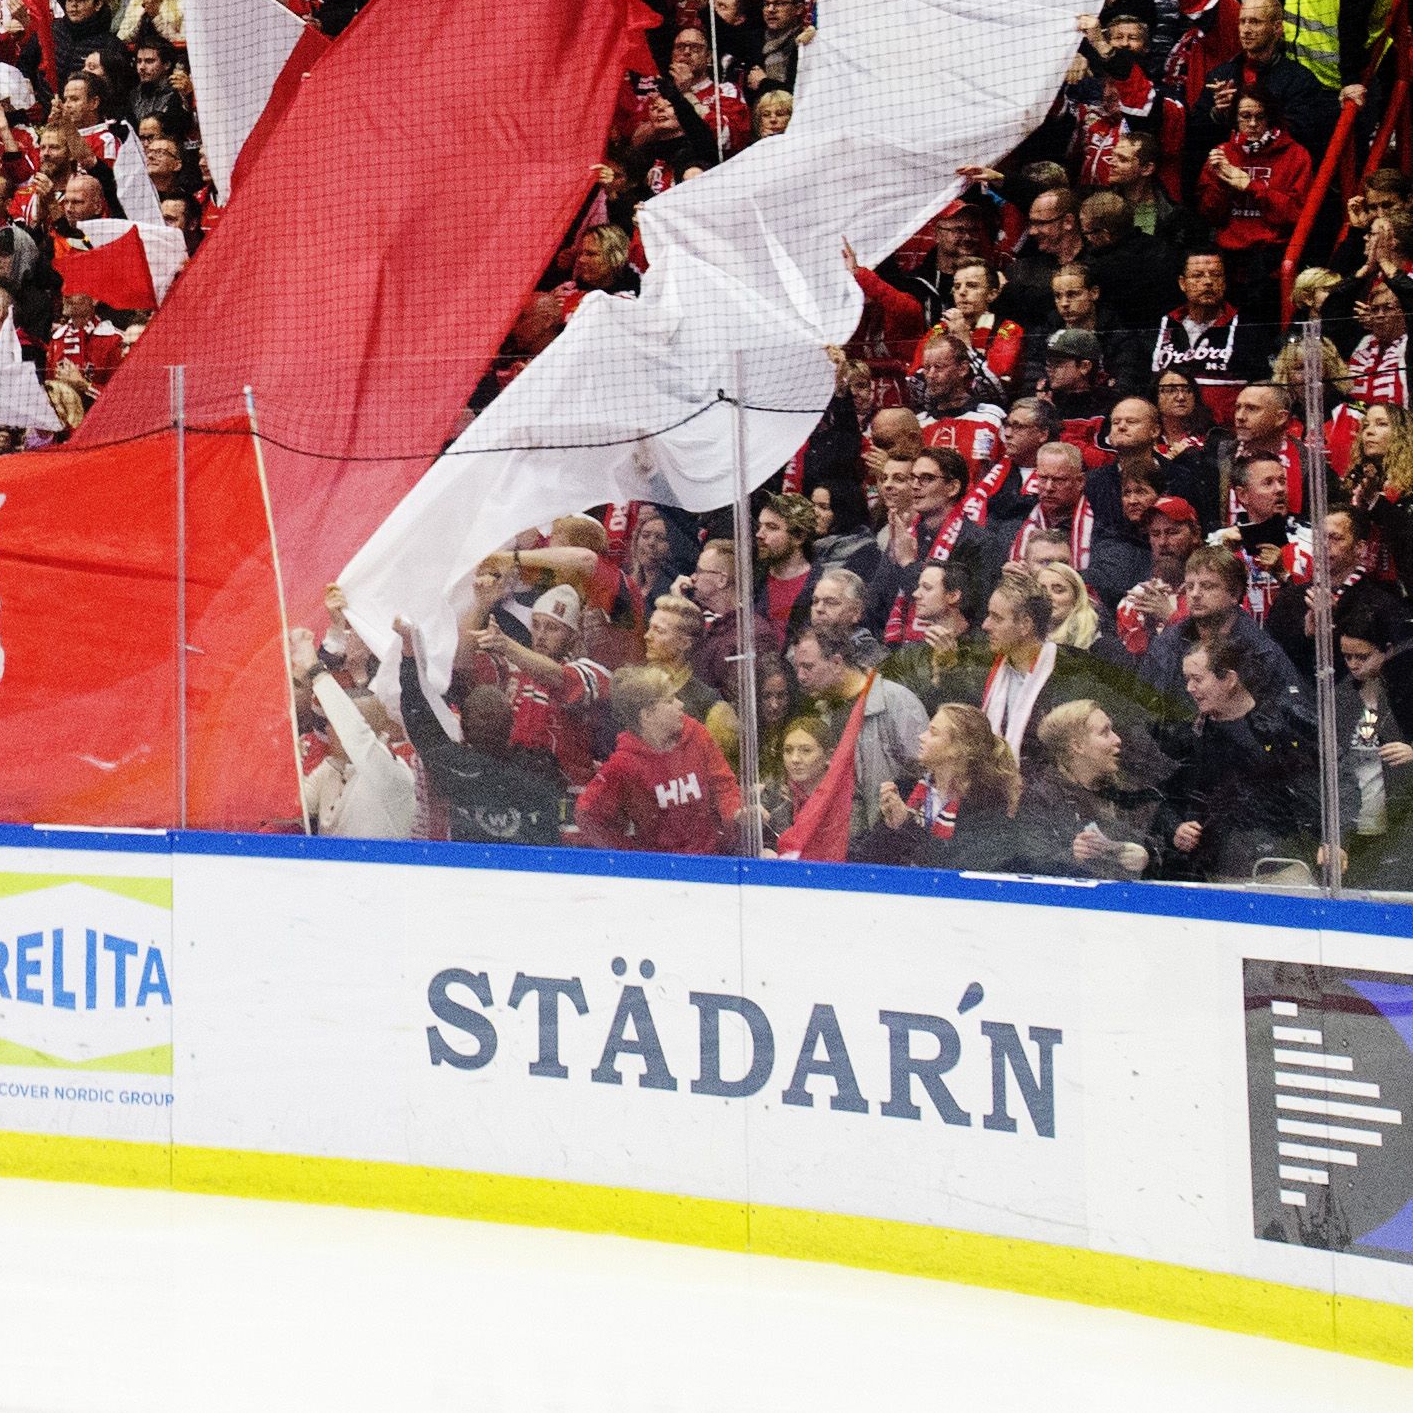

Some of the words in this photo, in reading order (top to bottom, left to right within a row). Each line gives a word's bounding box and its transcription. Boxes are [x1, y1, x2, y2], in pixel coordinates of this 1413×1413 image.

[654, 772, 703, 808] HH
[54, 1083, 115, 1103] NORDIC
[119, 1090, 175, 1107] GROUP
